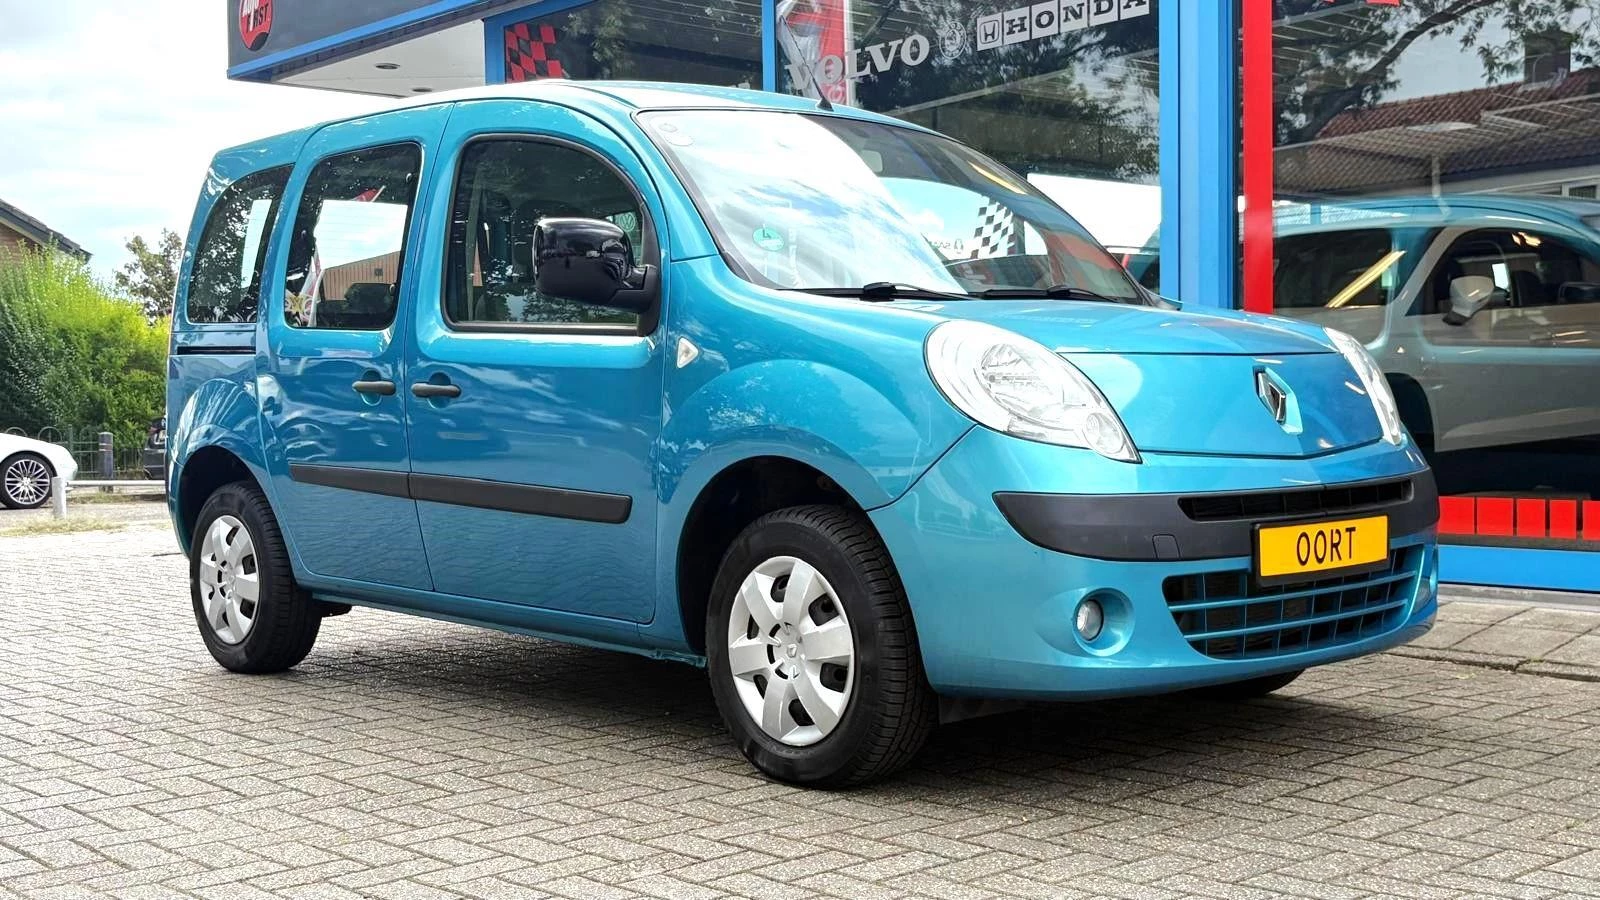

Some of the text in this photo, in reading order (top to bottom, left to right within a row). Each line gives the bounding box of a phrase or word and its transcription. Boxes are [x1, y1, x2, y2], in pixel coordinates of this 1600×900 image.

[1006, 0, 1147, 36] HONDA
[784, 34, 930, 90] VOLVO
[1296, 526, 1357, 566] OORT
